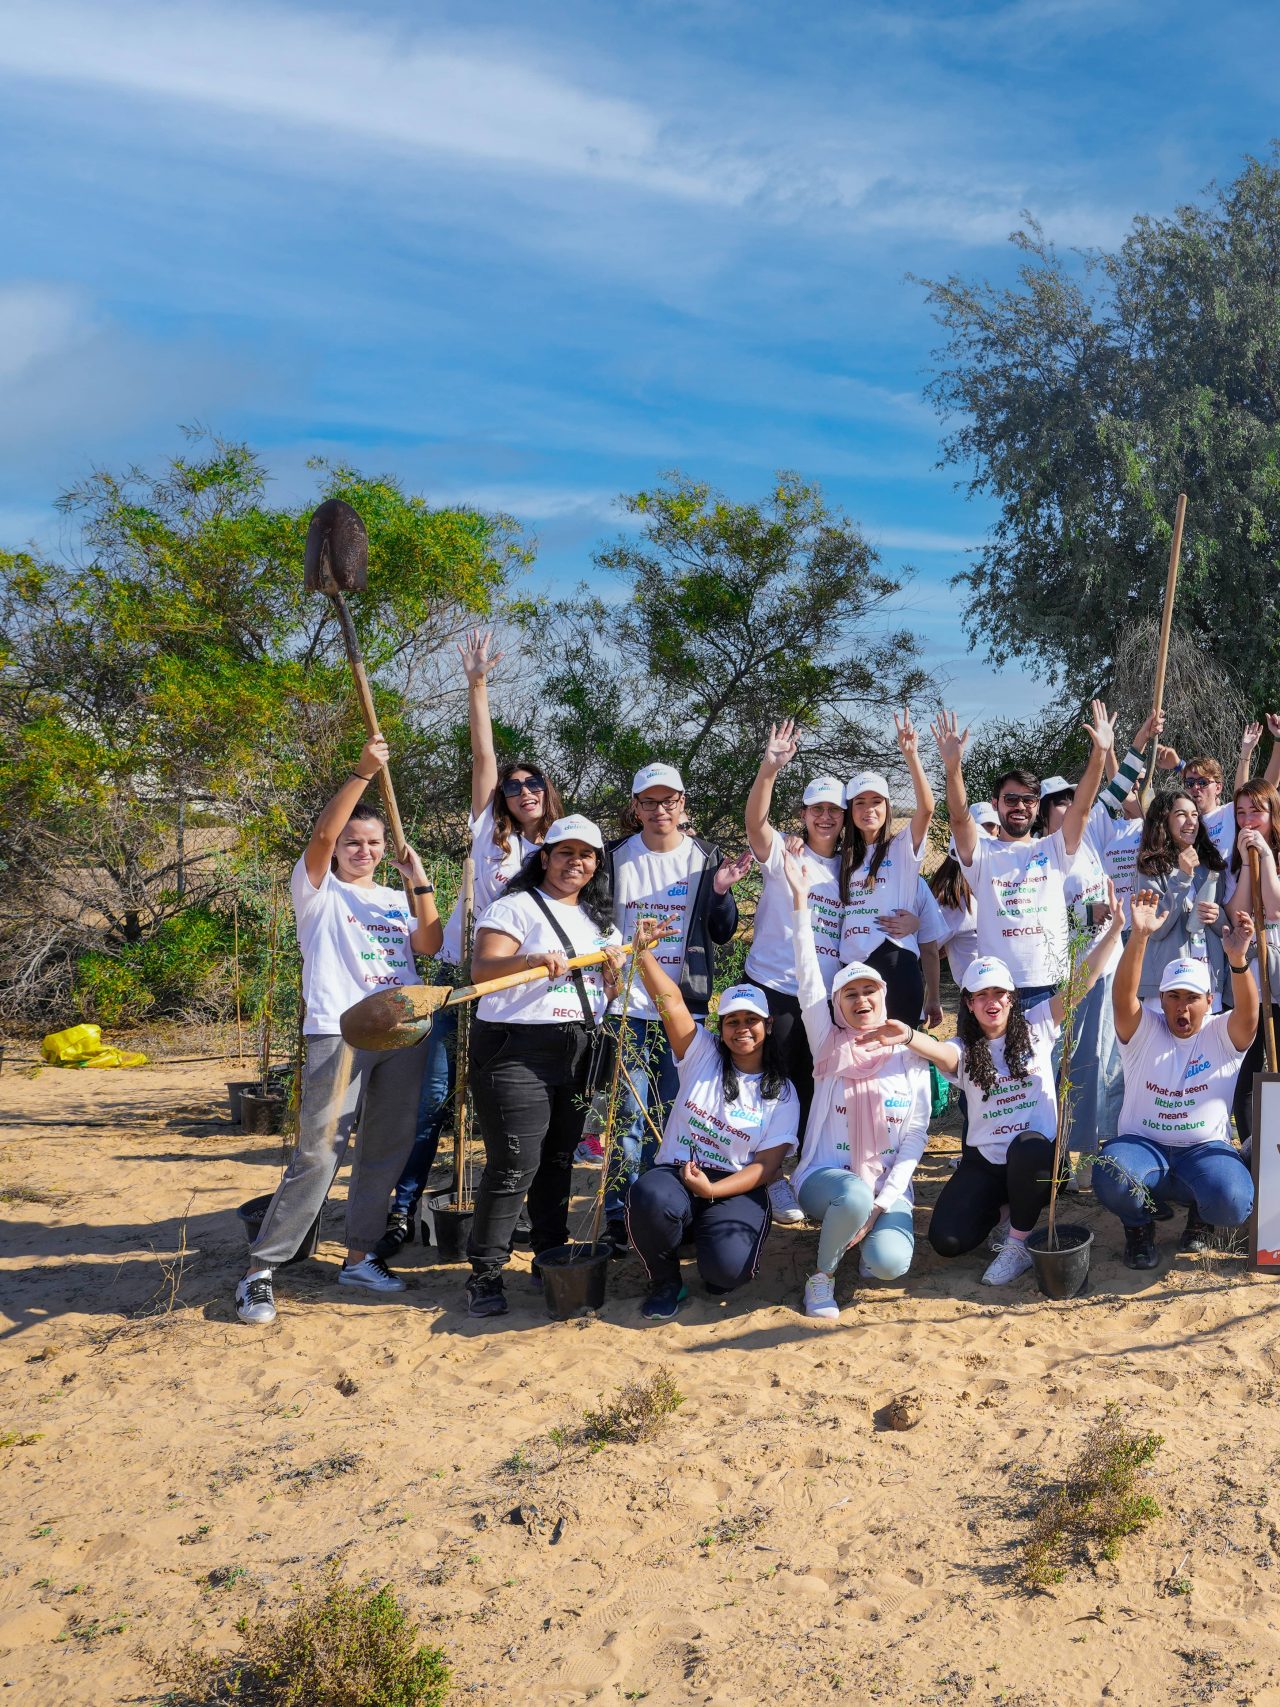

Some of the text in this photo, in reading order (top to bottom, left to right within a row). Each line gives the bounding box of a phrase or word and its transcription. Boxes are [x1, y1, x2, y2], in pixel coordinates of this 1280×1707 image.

[667, 885, 688, 897] deli
[651, 903, 669, 911] may
[824, 897, 840, 909] may
[1006, 898, 1031, 906] means
[829, 908, 837, 916] to
[852, 907, 879, 915] nature
[367, 924, 390, 933] may
[660, 935, 684, 943] natur
[654, 956, 681, 965] YCLE!
[1185, 1060, 1211, 1079] elice
[989, 1086, 1008, 1096] ittle
[1146, 1081, 1169, 1095] What
[1184, 1084, 1208, 1094] seem
[996, 1092, 1026, 1105] means
[1155, 1097, 1173, 1108] little
[989, 1110, 1002, 1118] lot
[684, 1099, 751, 1142] What may seem
[1148, 1120, 1160, 1129] lot
[1174, 1120, 1205, 1130] nature
[687, 1116, 732, 1146] little to us
[992, 1122, 1030, 1135] ECYCLE
